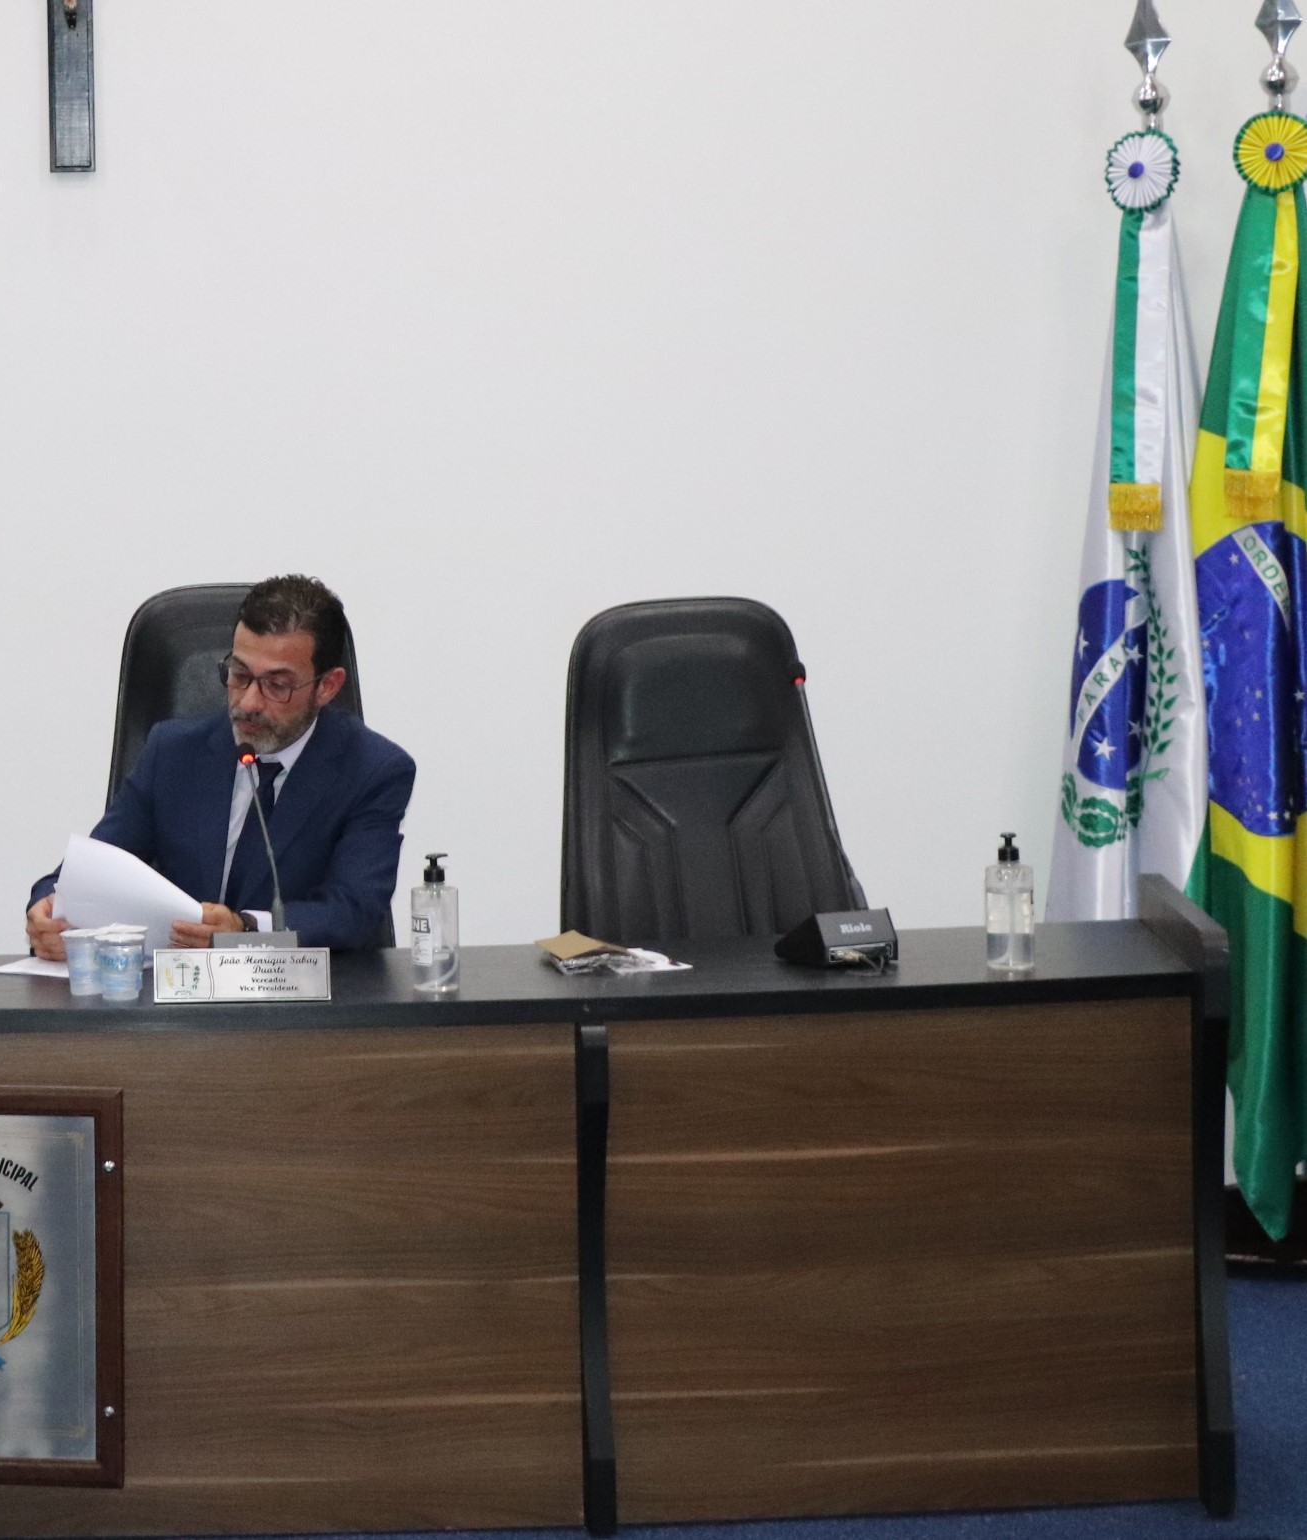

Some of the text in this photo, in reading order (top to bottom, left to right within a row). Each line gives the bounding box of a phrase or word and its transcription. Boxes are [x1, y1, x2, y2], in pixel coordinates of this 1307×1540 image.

[840, 922, 872, 934] Riole
[219, 955, 240, 967] João
[244, 955, 287, 966] Henrique
[253, 965, 285, 974] Duarte
